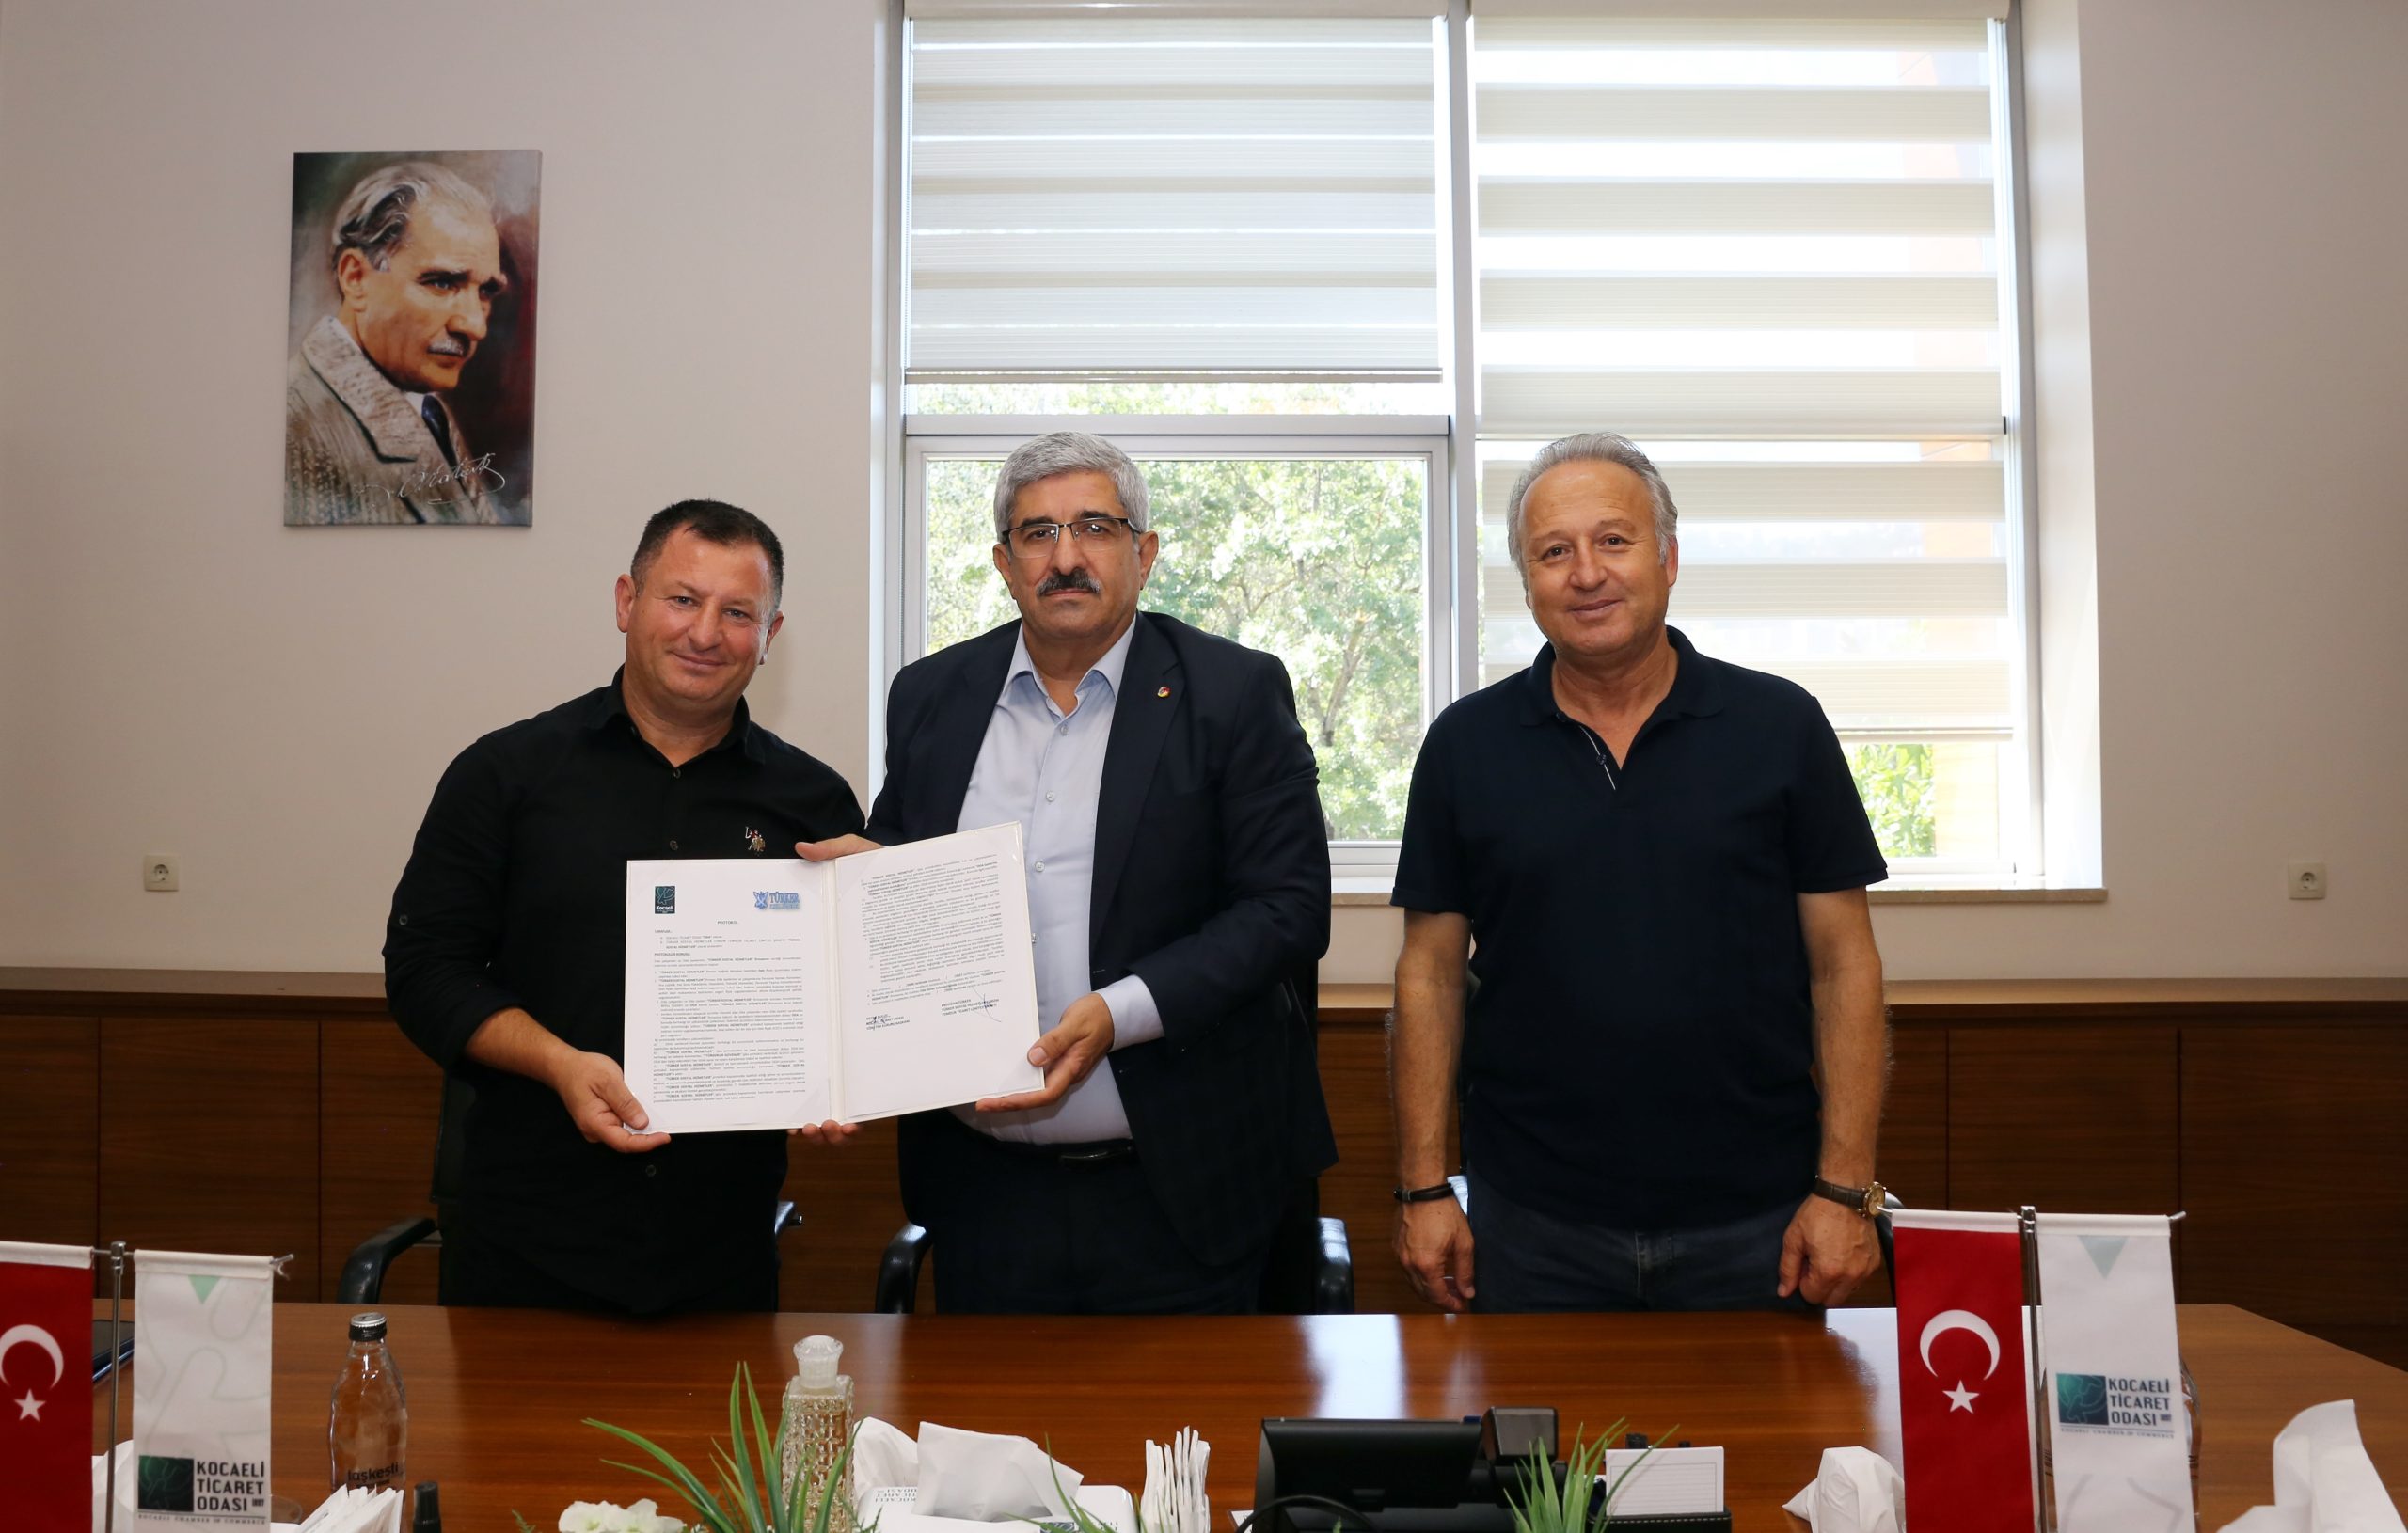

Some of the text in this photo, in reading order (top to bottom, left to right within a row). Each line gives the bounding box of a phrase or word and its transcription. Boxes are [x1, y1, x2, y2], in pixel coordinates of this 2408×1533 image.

[2109, 1378, 2169, 1393] KOCAELİ
[2110, 1393, 2170, 1410] TİCARET
[2112, 1412, 2157, 1426] ODASI
[197, 1461, 264, 1478] KOCAELİ
[197, 1477, 264, 1495] TİCARET
[197, 1496, 247, 1511] ODASI
